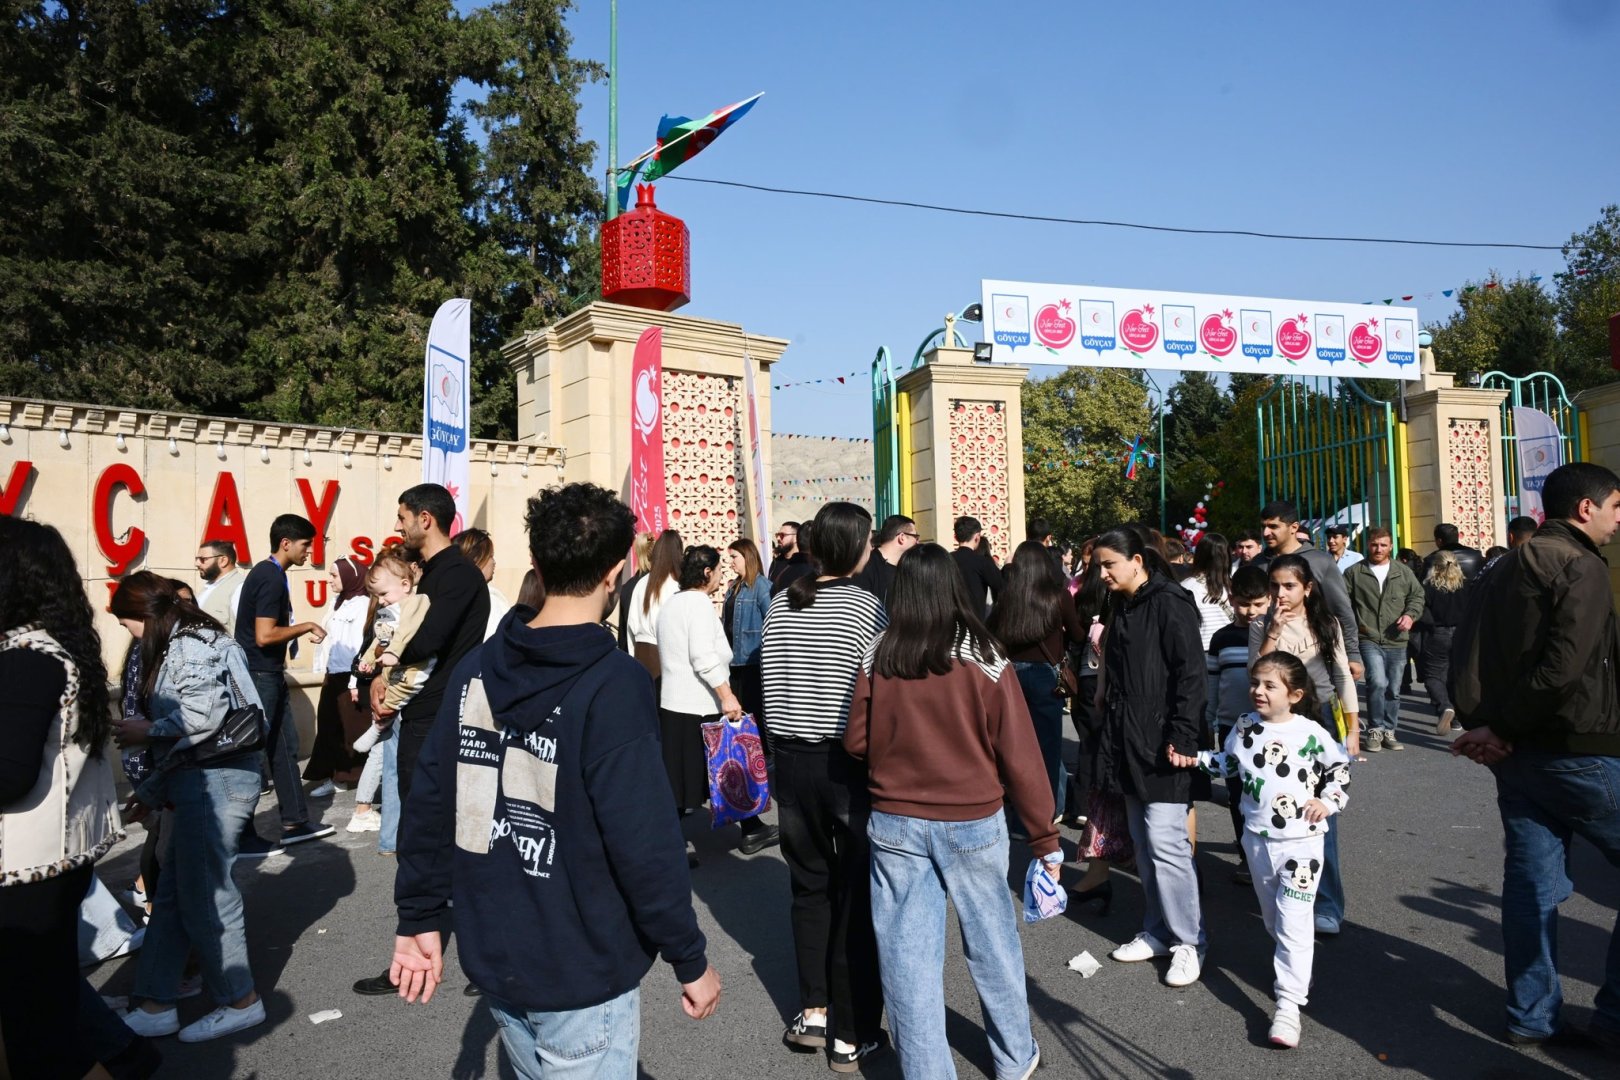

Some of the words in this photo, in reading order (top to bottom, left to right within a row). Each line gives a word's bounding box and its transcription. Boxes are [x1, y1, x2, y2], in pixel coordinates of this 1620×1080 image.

[997, 334, 1027, 344] GÖYÇAY
[1084, 338, 1113, 348] GÖYÇAY
[1166, 342, 1194, 353] GÖYÇAY
[1244, 346, 1271, 355] GÖYÇAY
[1318, 350, 1343, 359] GÖYÇAY
[1388, 353, 1412, 362] GÖYÇAY
[430, 425, 461, 446] GÖYÇAY
[654, 506, 663, 534] 2025
[462, 729, 477, 738] NO
[460, 738, 487, 749] HARD
[459, 748, 500, 762] FEELINGS
